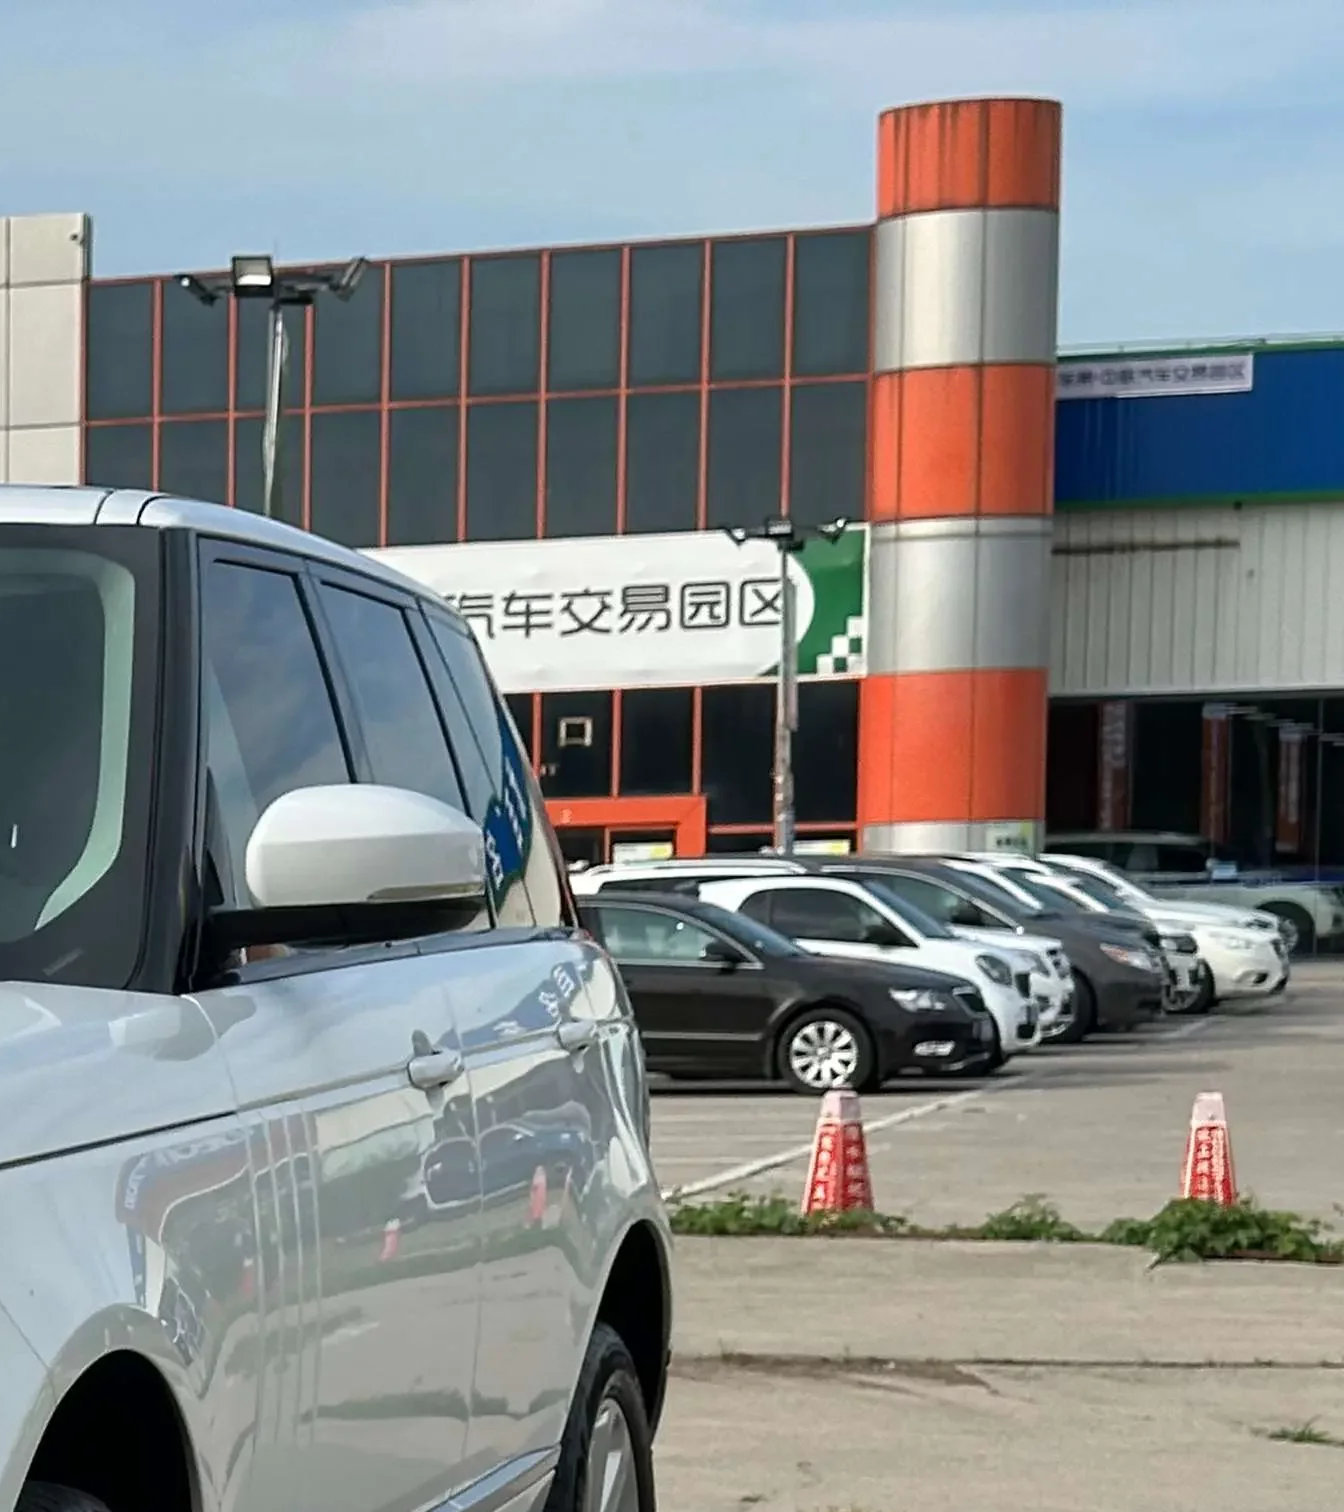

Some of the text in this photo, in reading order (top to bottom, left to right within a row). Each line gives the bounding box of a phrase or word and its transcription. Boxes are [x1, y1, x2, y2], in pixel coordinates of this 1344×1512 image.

[446, 578, 784, 640] 汽车交易园区
